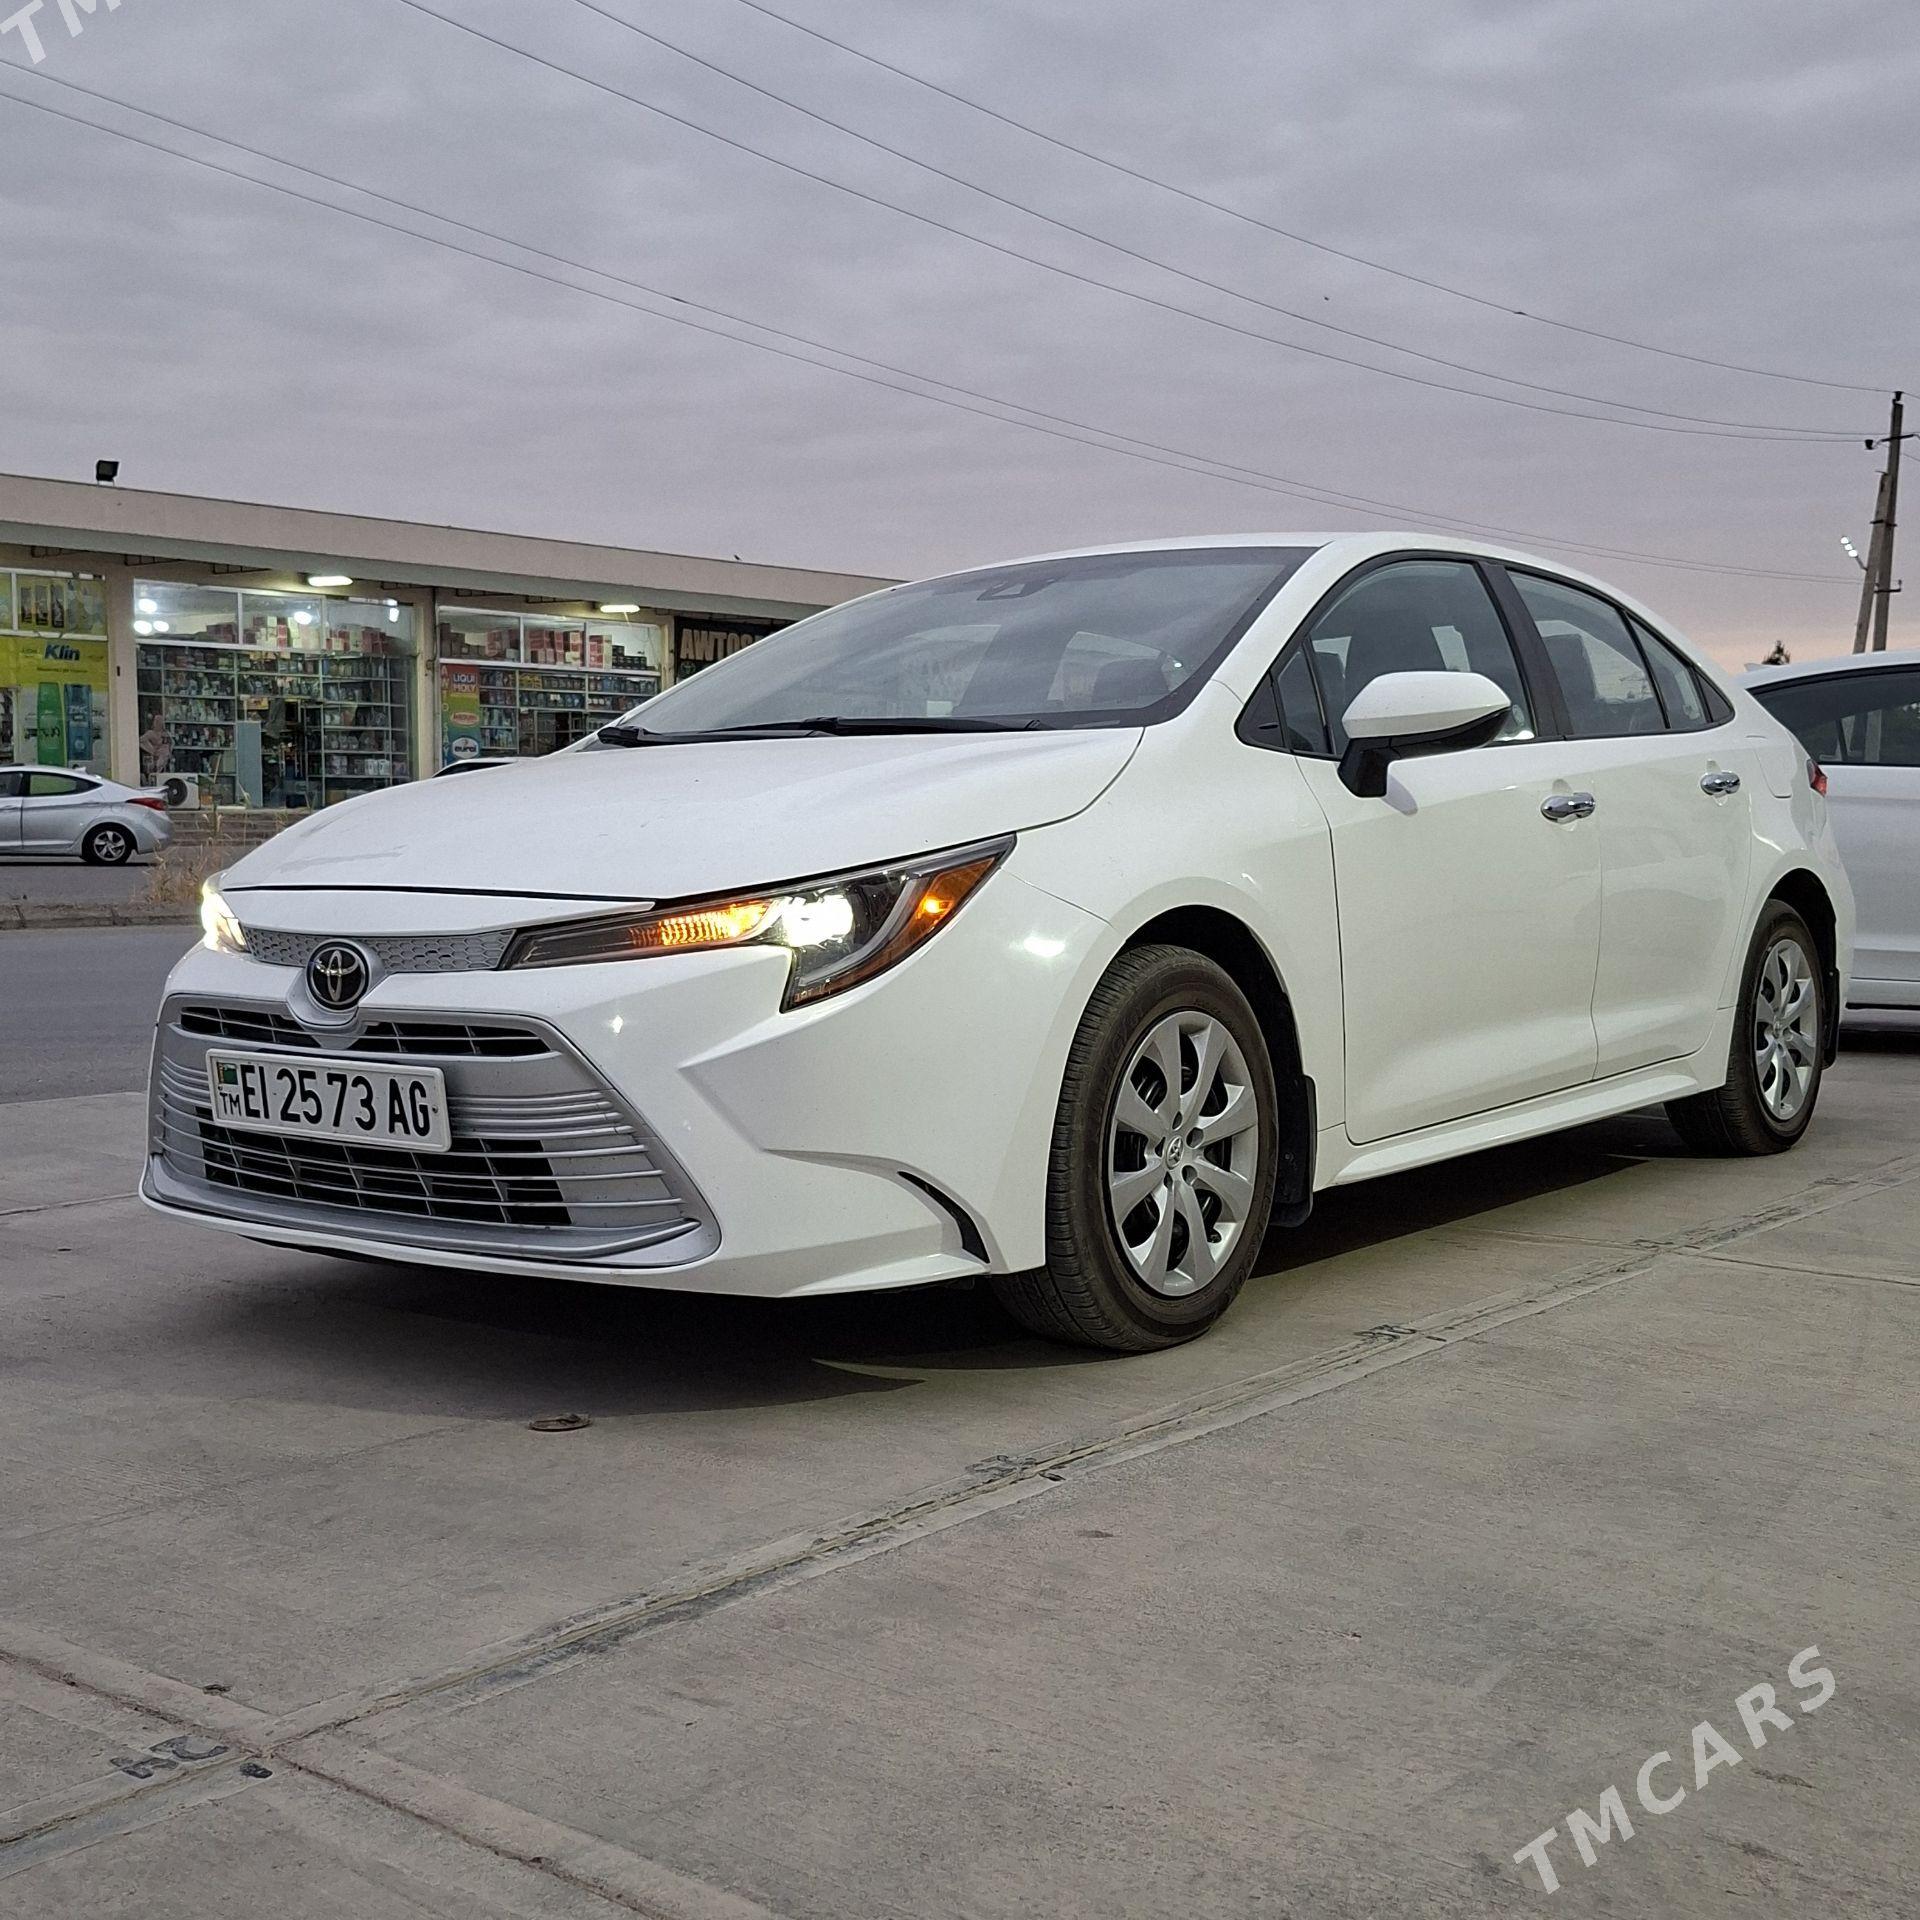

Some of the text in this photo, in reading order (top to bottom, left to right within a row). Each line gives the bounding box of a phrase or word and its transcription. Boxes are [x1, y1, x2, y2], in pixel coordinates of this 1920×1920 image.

[680, 628, 764, 661] AWTO
[44, 645, 80, 660] Klin
[453, 673, 474, 682] LIQUI
[453, 684, 475, 692] MOLY
[220, 1092, 241, 1116] TM
[276, 1068, 376, 1131] 2573
[388, 1079, 430, 1136] AG
